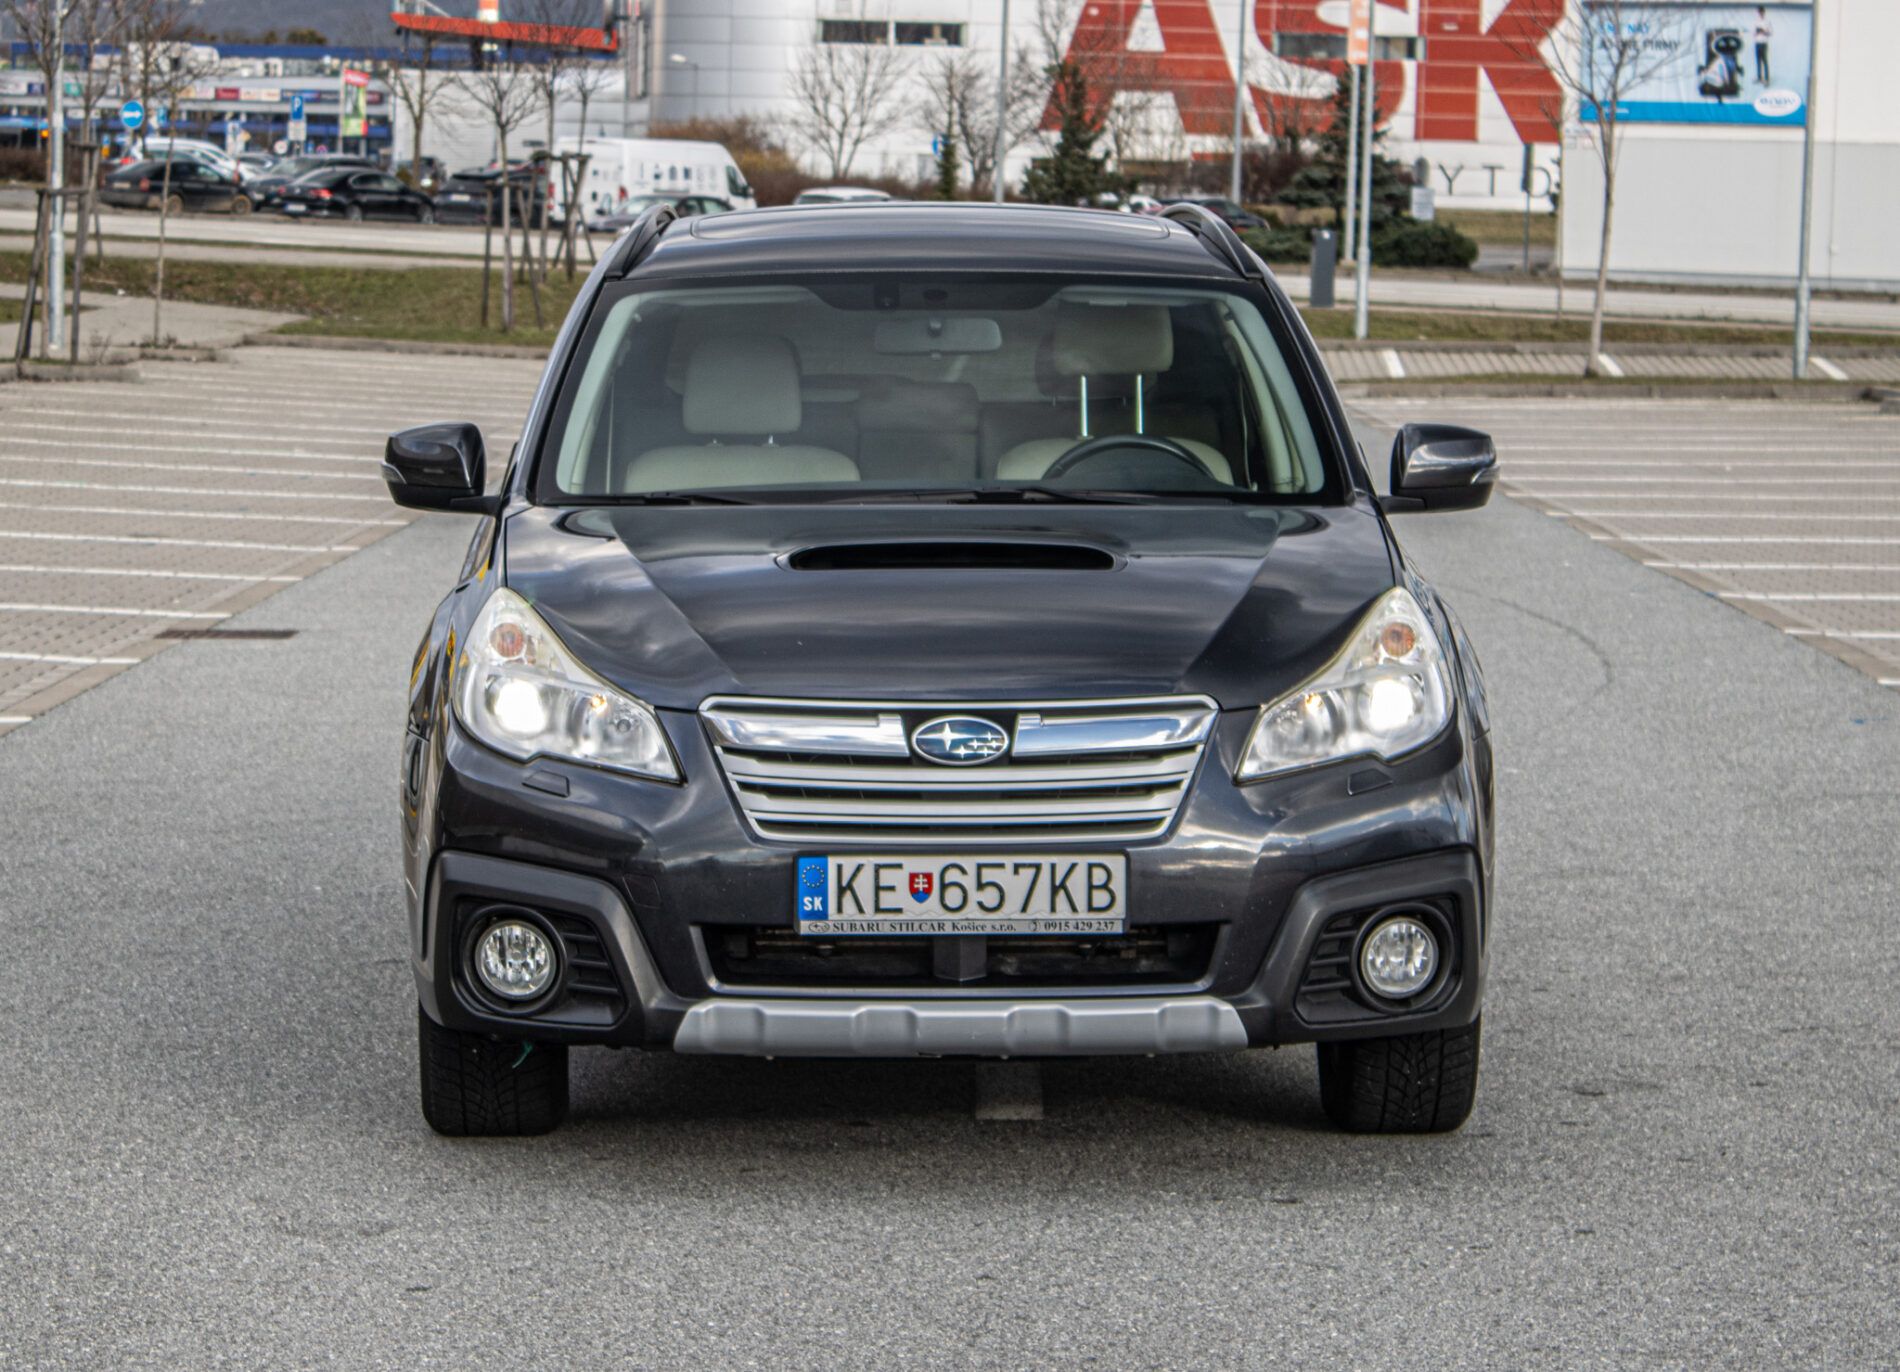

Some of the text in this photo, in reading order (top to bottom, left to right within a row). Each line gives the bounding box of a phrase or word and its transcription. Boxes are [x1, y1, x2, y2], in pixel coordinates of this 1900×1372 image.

[836, 862, 1117, 915] KE 657KB
[803, 896, 823, 911] SK
[832, 920, 1115, 933] SUBARU STILCAR Košice s.r.o. 0915 429 237
